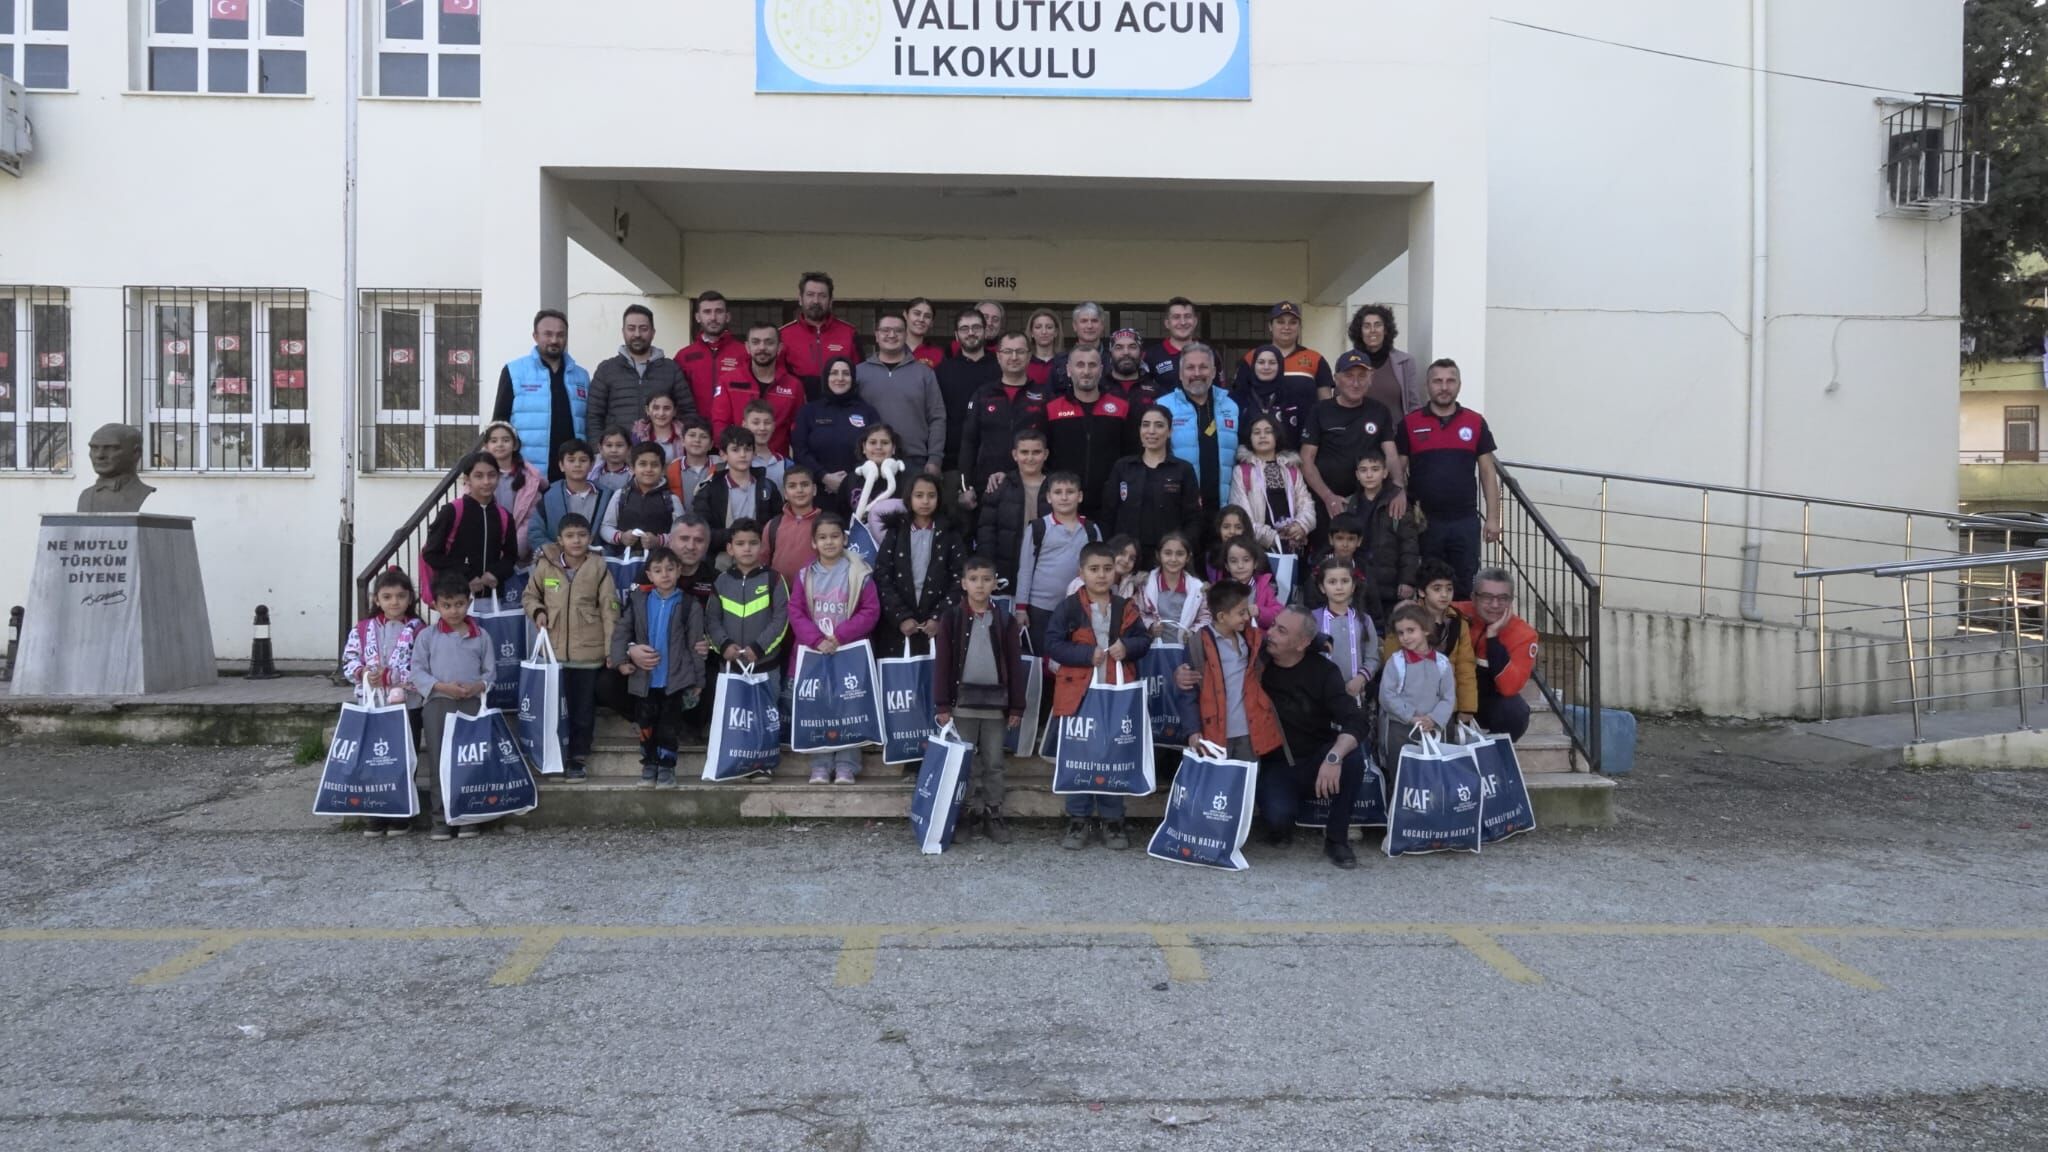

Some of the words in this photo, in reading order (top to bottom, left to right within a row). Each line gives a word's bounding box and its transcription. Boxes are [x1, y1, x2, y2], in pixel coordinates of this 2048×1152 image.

[995, 0, 1101, 32] UTKU
[1114, 1, 1223, 33] ACUN
[894, 36, 1095, 79] İLKOKULU
[47, 540, 68, 551] NE
[74, 540, 128, 550] MUTLU
[60, 554, 127, 567] TÜRKÜM
[68, 570, 127, 583] DİYENE
[799, 678, 819, 698] KAF
[887, 689, 913, 711] KAF
[729, 706, 754, 729] KAF
[1065, 716, 1094, 738] KAF
[458, 741, 487, 763] KAF
[1481, 774, 1497, 796] AF
[1402, 786, 1430, 810] KAF
